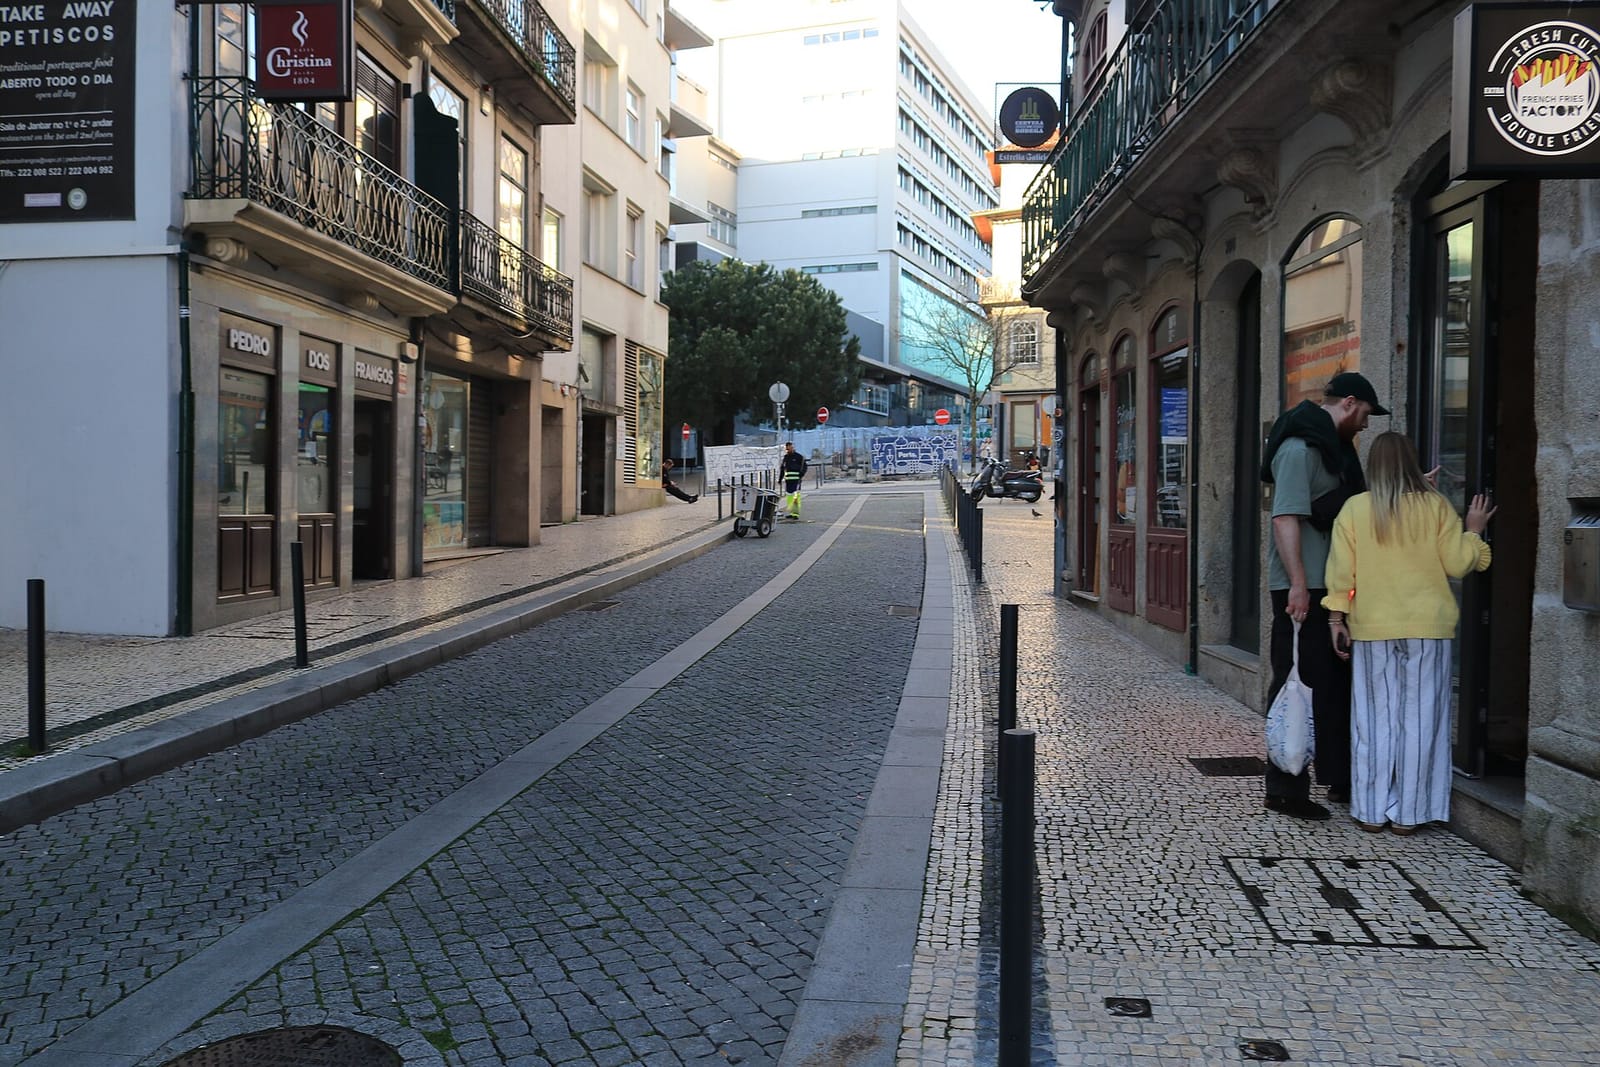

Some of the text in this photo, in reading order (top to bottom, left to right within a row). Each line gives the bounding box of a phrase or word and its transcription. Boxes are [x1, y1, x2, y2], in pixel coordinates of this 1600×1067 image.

[0, 1, 114, 23] TAKE AWAY
[0, 25, 114, 46] PETISCOS
[1511, 29, 1598, 58] FRESH CUT
[0, 57, 114, 73] traditional portuguese food
[266, 47, 332, 77] Christina
[0, 74, 113, 89] ABERTO TODO O DIA
[35, 92, 52, 101] open
[63, 90, 77, 100] day
[1521, 94, 1585, 103] FRENCH FRIES
[1521, 105, 1585, 117] FACTORY
[0, 123, 15, 132] Sala
[16, 122, 26, 131] de
[27, 122, 51, 130] Jantar
[92, 119, 113, 128] andar
[1500, 112, 1600, 148] DOUBLE FRIED
[17, 169, 32, 177] 222
[68, 167, 82, 175] 222
[228, 328, 270, 356] PEDRO
[308, 350, 331, 371] DOS
[355, 361, 394, 385] FRANGOS
